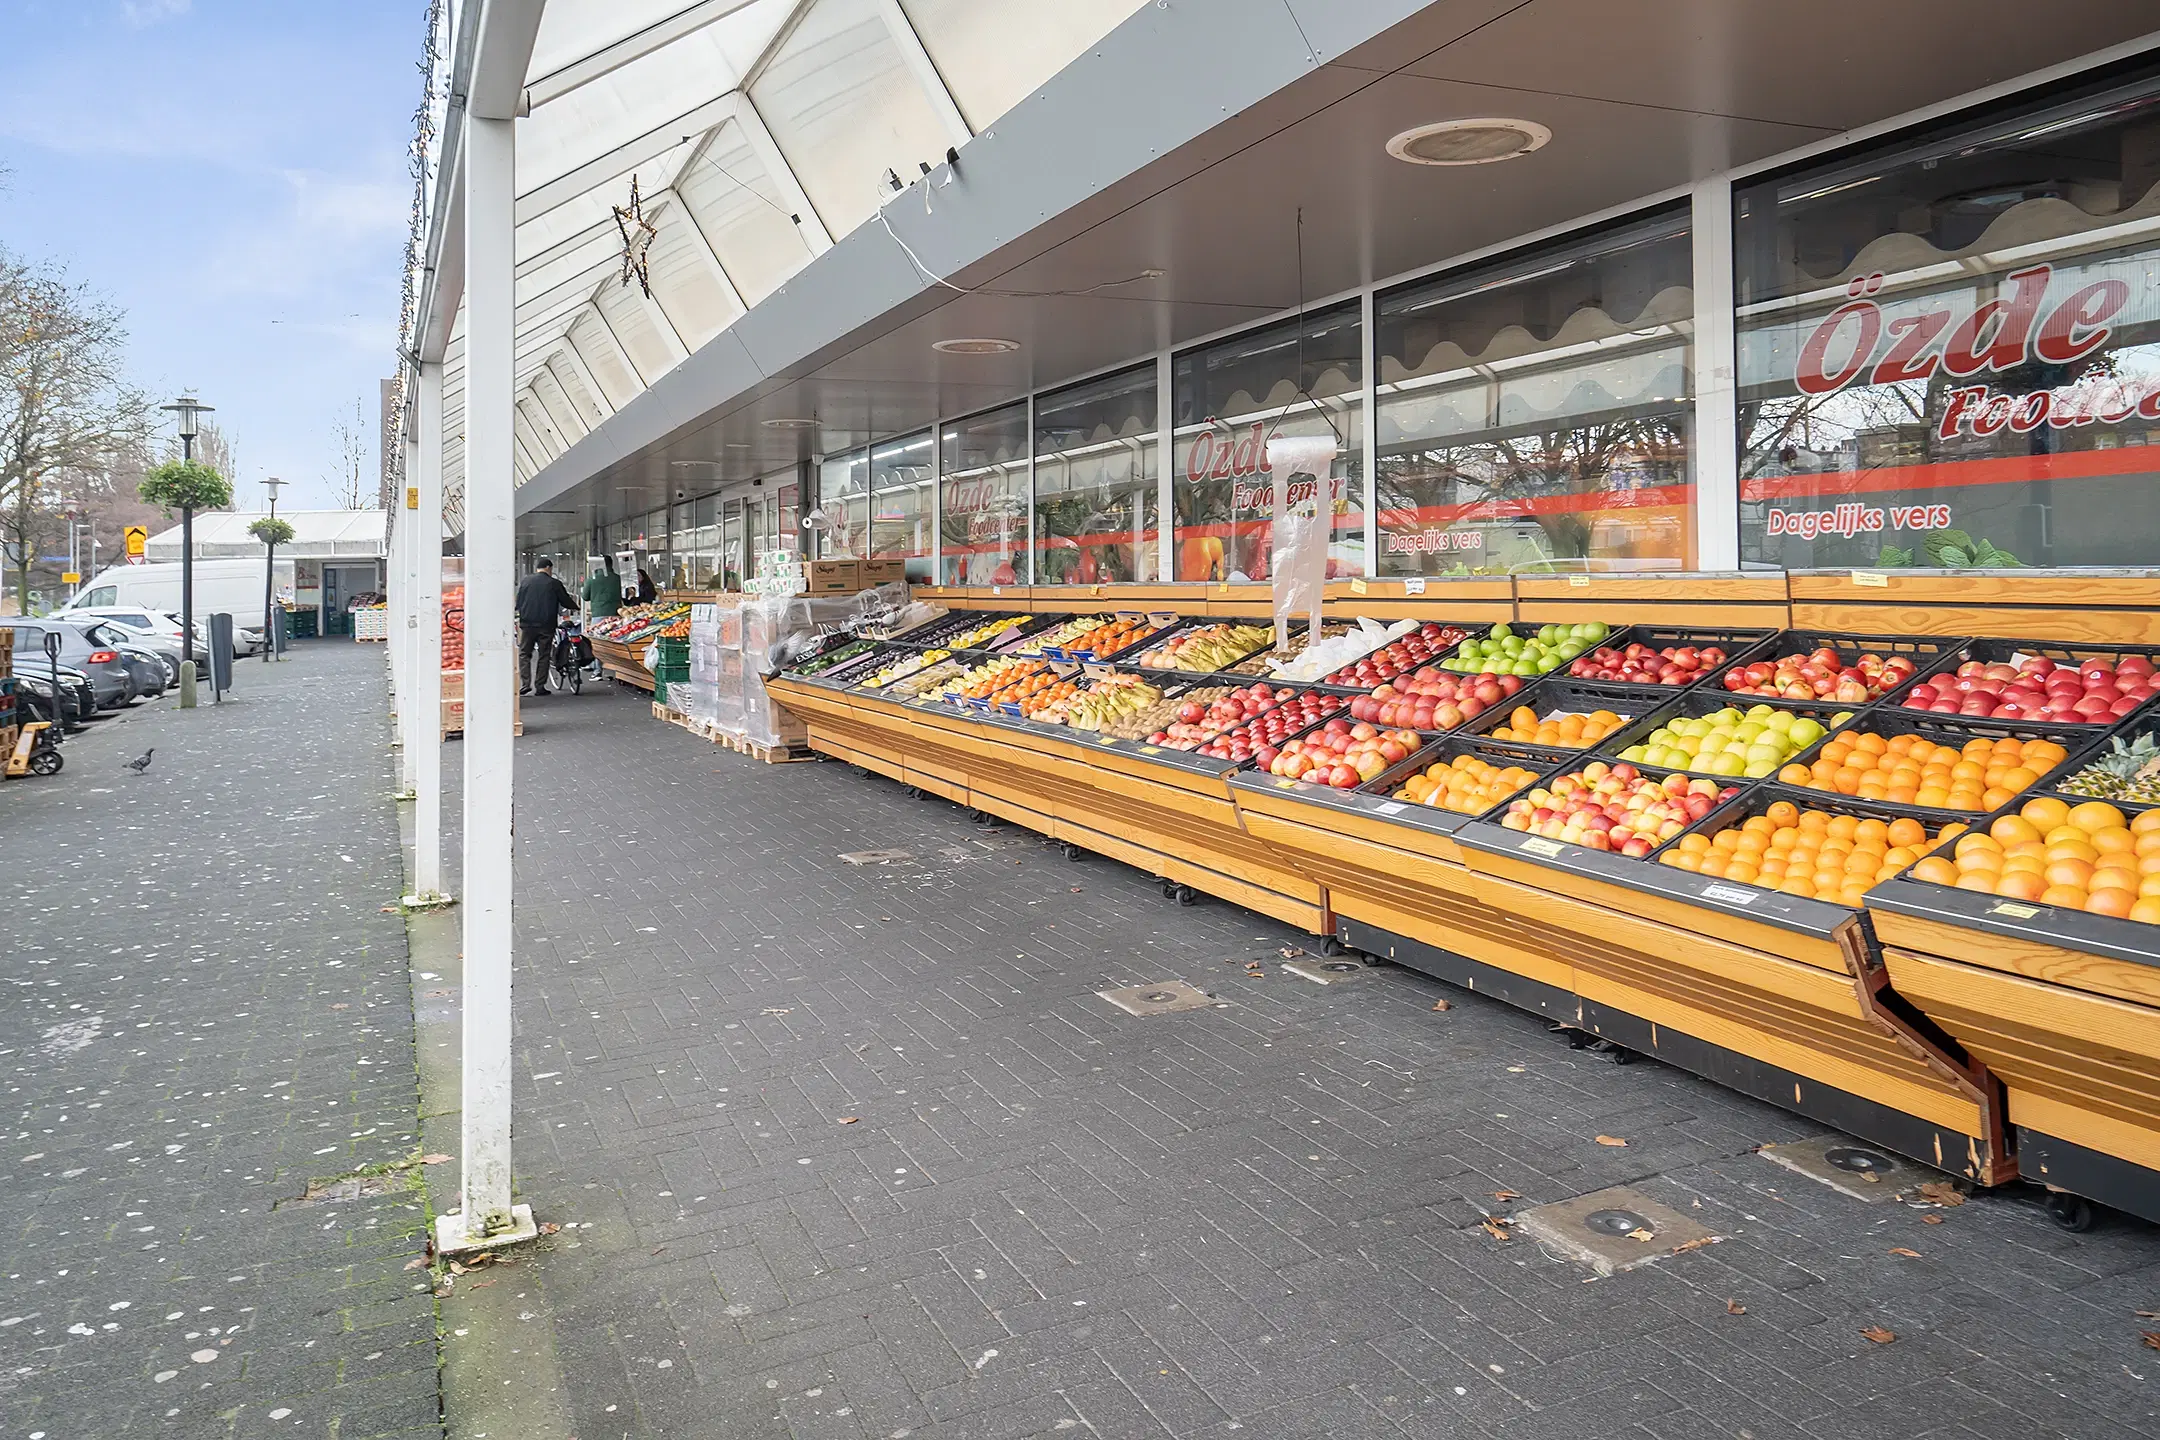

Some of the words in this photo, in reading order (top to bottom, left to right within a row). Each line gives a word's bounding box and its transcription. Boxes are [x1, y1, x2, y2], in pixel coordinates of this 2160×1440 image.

[1795, 263, 2130, 396] Özde
[1767, 502, 1885, 540] Dagelijks
[1891, 503, 1951, 530] vers
[1388, 528, 1450, 555] Dagelijks
[1451, 531, 1483, 549] vers
